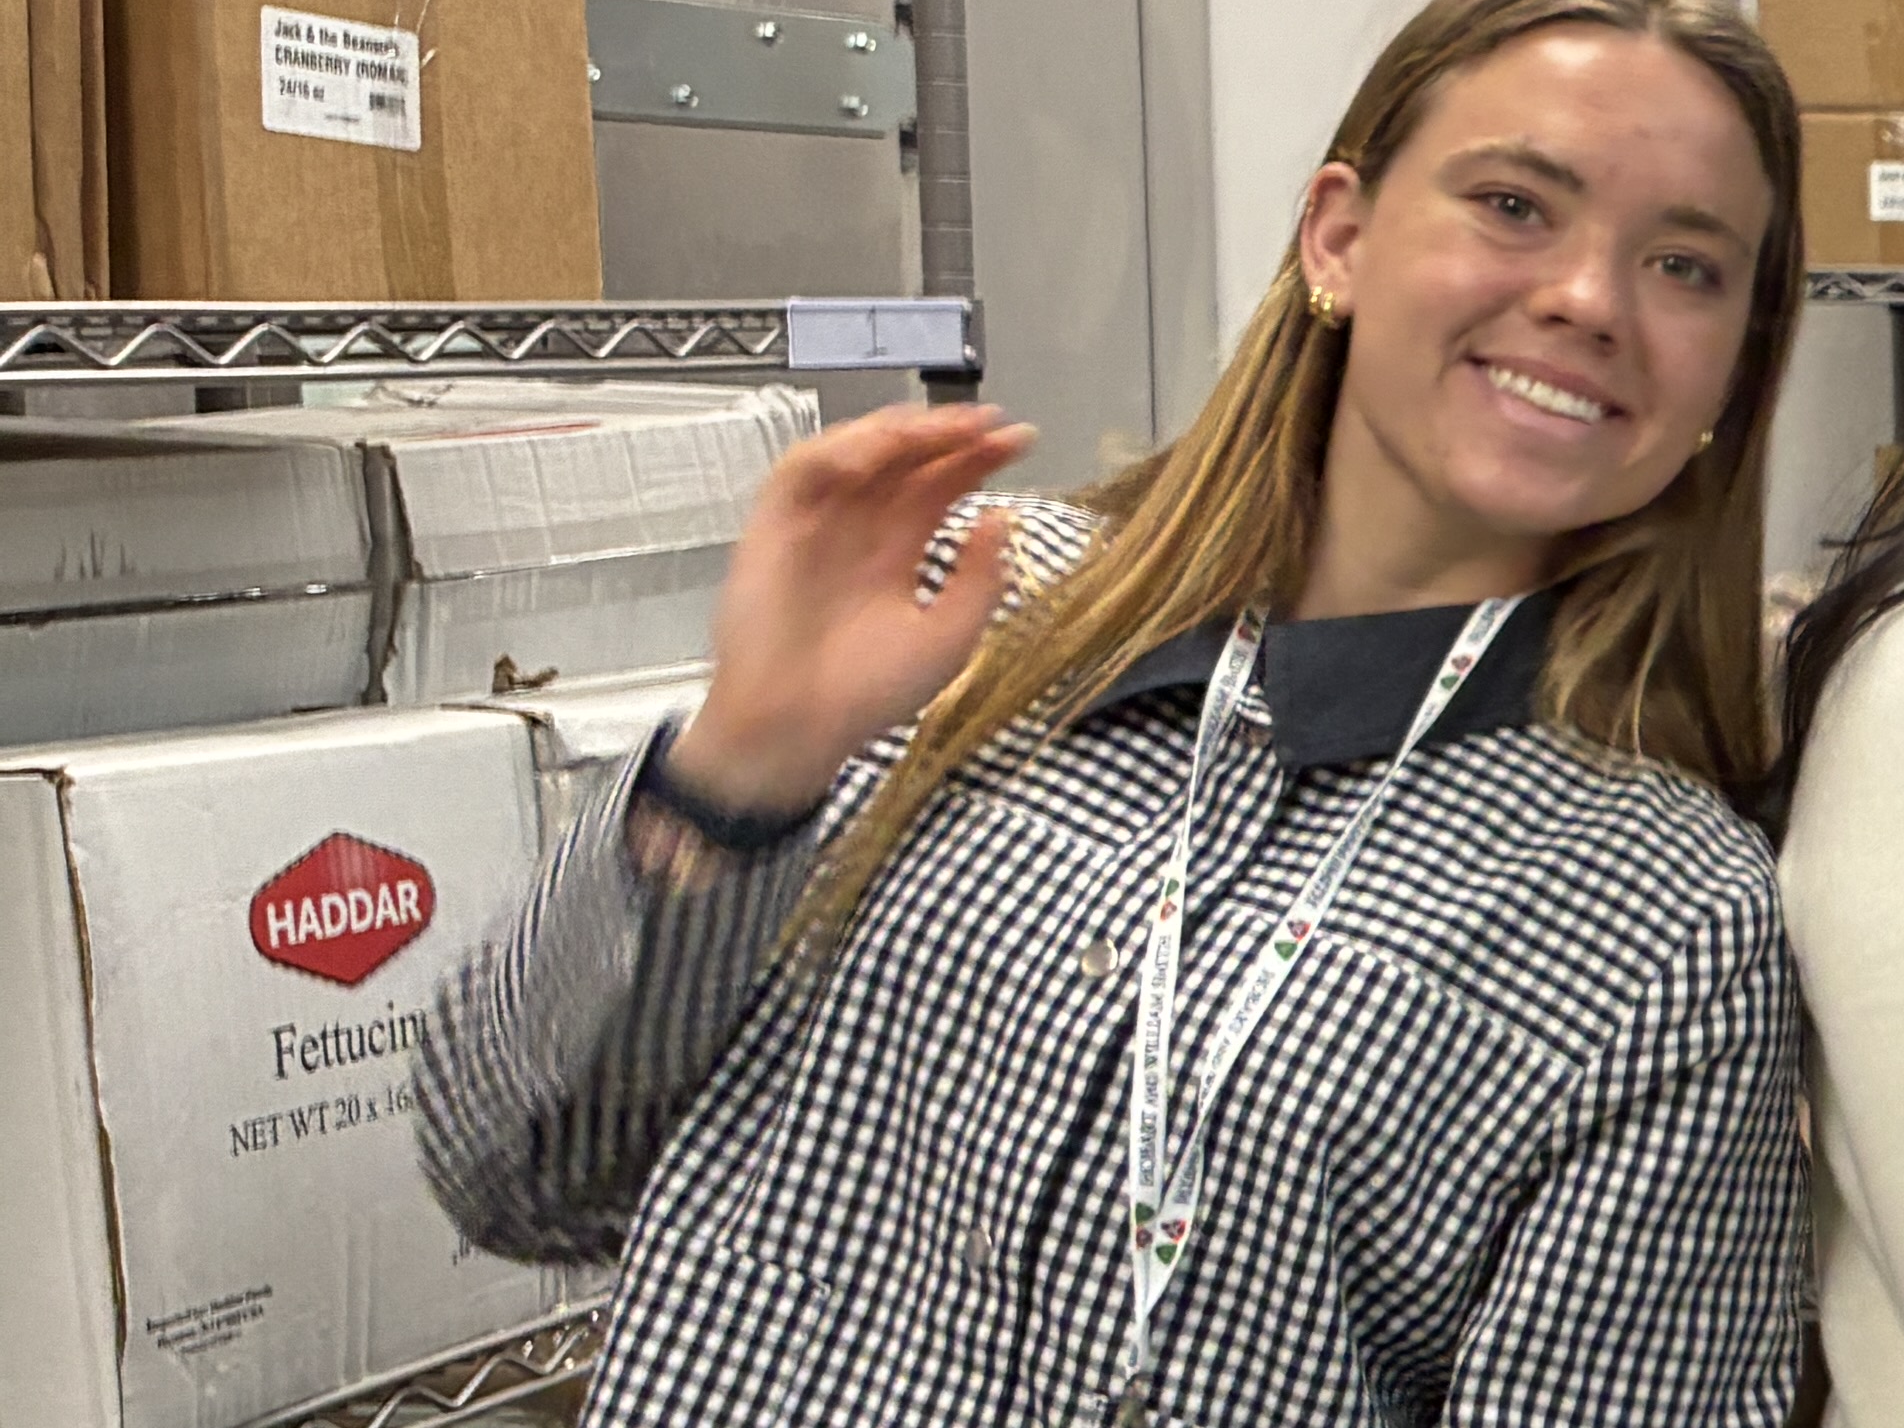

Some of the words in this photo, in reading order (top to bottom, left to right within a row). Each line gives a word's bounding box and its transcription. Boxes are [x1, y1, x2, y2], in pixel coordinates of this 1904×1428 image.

[274, 18, 302, 42] Jack
[275, 44, 351, 77] CRANBERRY
[279, 75, 310, 100] 24/16
[266, 878, 423, 950] HADDAR
[229, 1114, 284, 1158] NET
[288, 1100, 331, 1141] WT
[334, 1089, 361, 1131] 20
[365, 1096, 379, 1124] x
